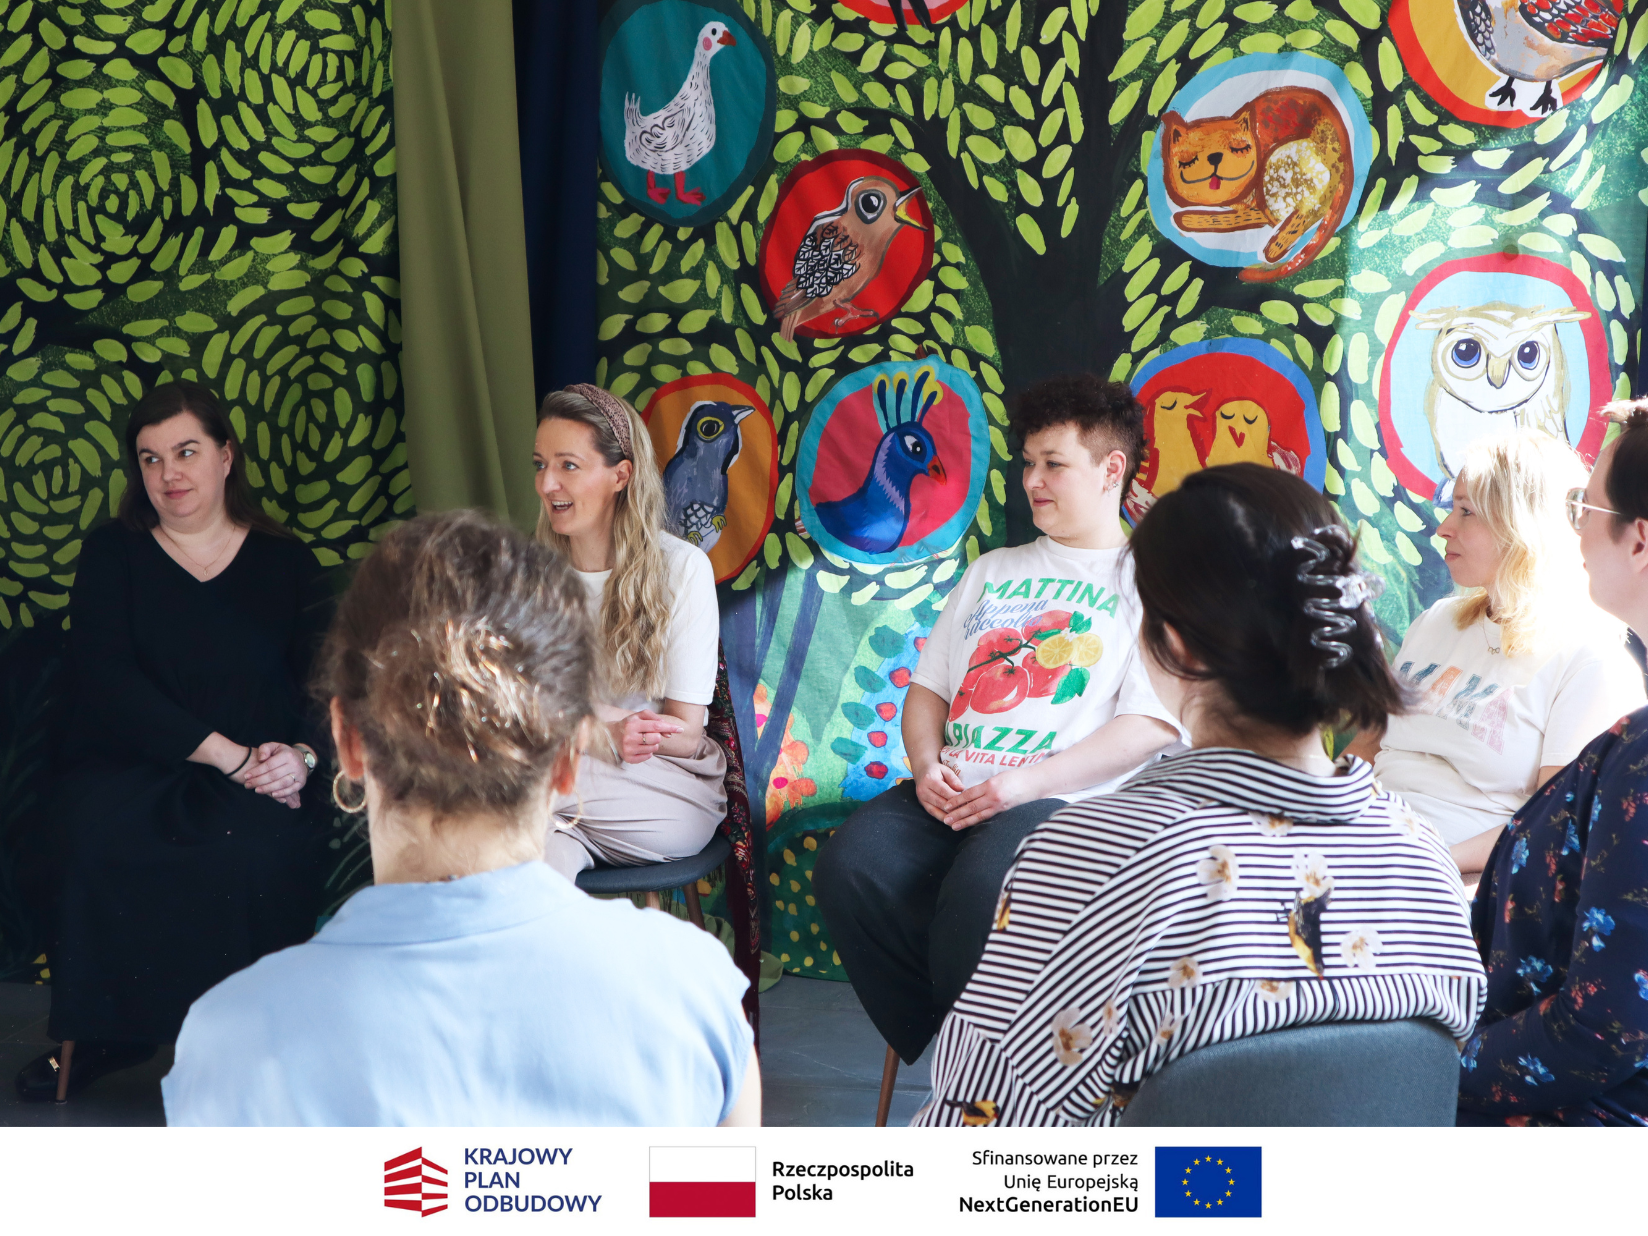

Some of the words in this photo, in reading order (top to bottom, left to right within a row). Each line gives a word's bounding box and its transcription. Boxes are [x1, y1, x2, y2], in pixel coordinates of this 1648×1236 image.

[977, 577, 1120, 619] MATTINA
[963, 599, 1049, 628] Appena
[965, 749, 996, 765] VITA
